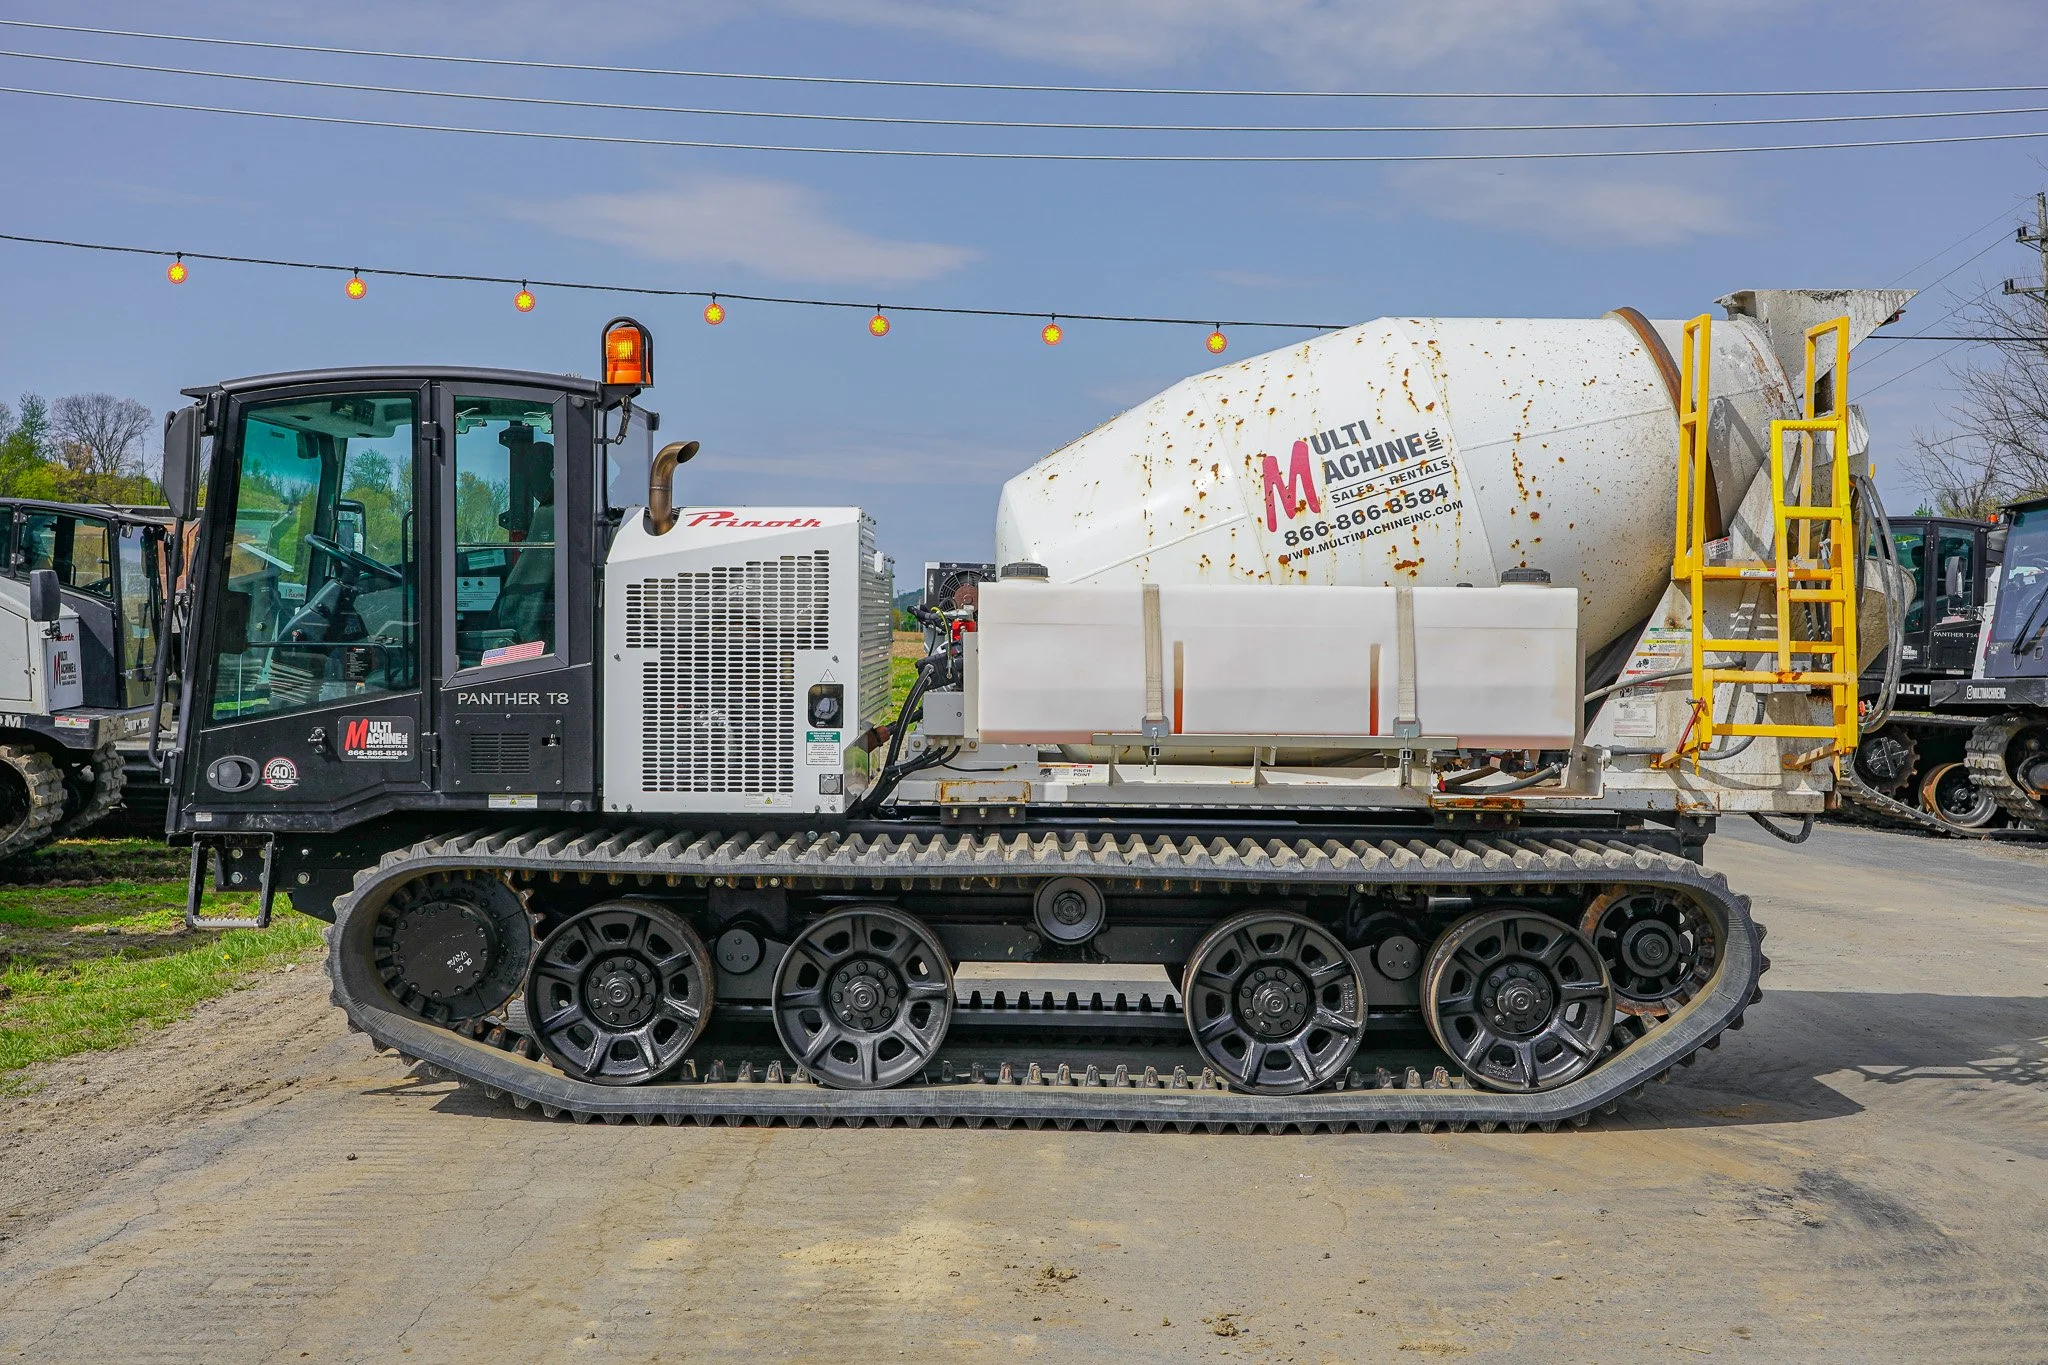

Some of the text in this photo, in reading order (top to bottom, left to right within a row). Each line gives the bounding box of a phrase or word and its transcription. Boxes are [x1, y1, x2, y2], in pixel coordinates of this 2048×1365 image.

[1427, 427, 1443, 452] INC.
[1331, 484, 1375, 504] SALES
[1390, 459, 1451, 485] RENTALS
[686, 511, 822, 527] Prinoth
[1284, 483, 1449, 547] 866-866-8584
[457, 693, 569, 705] PANTHER T8
[272, 766, 289, 779] 40
